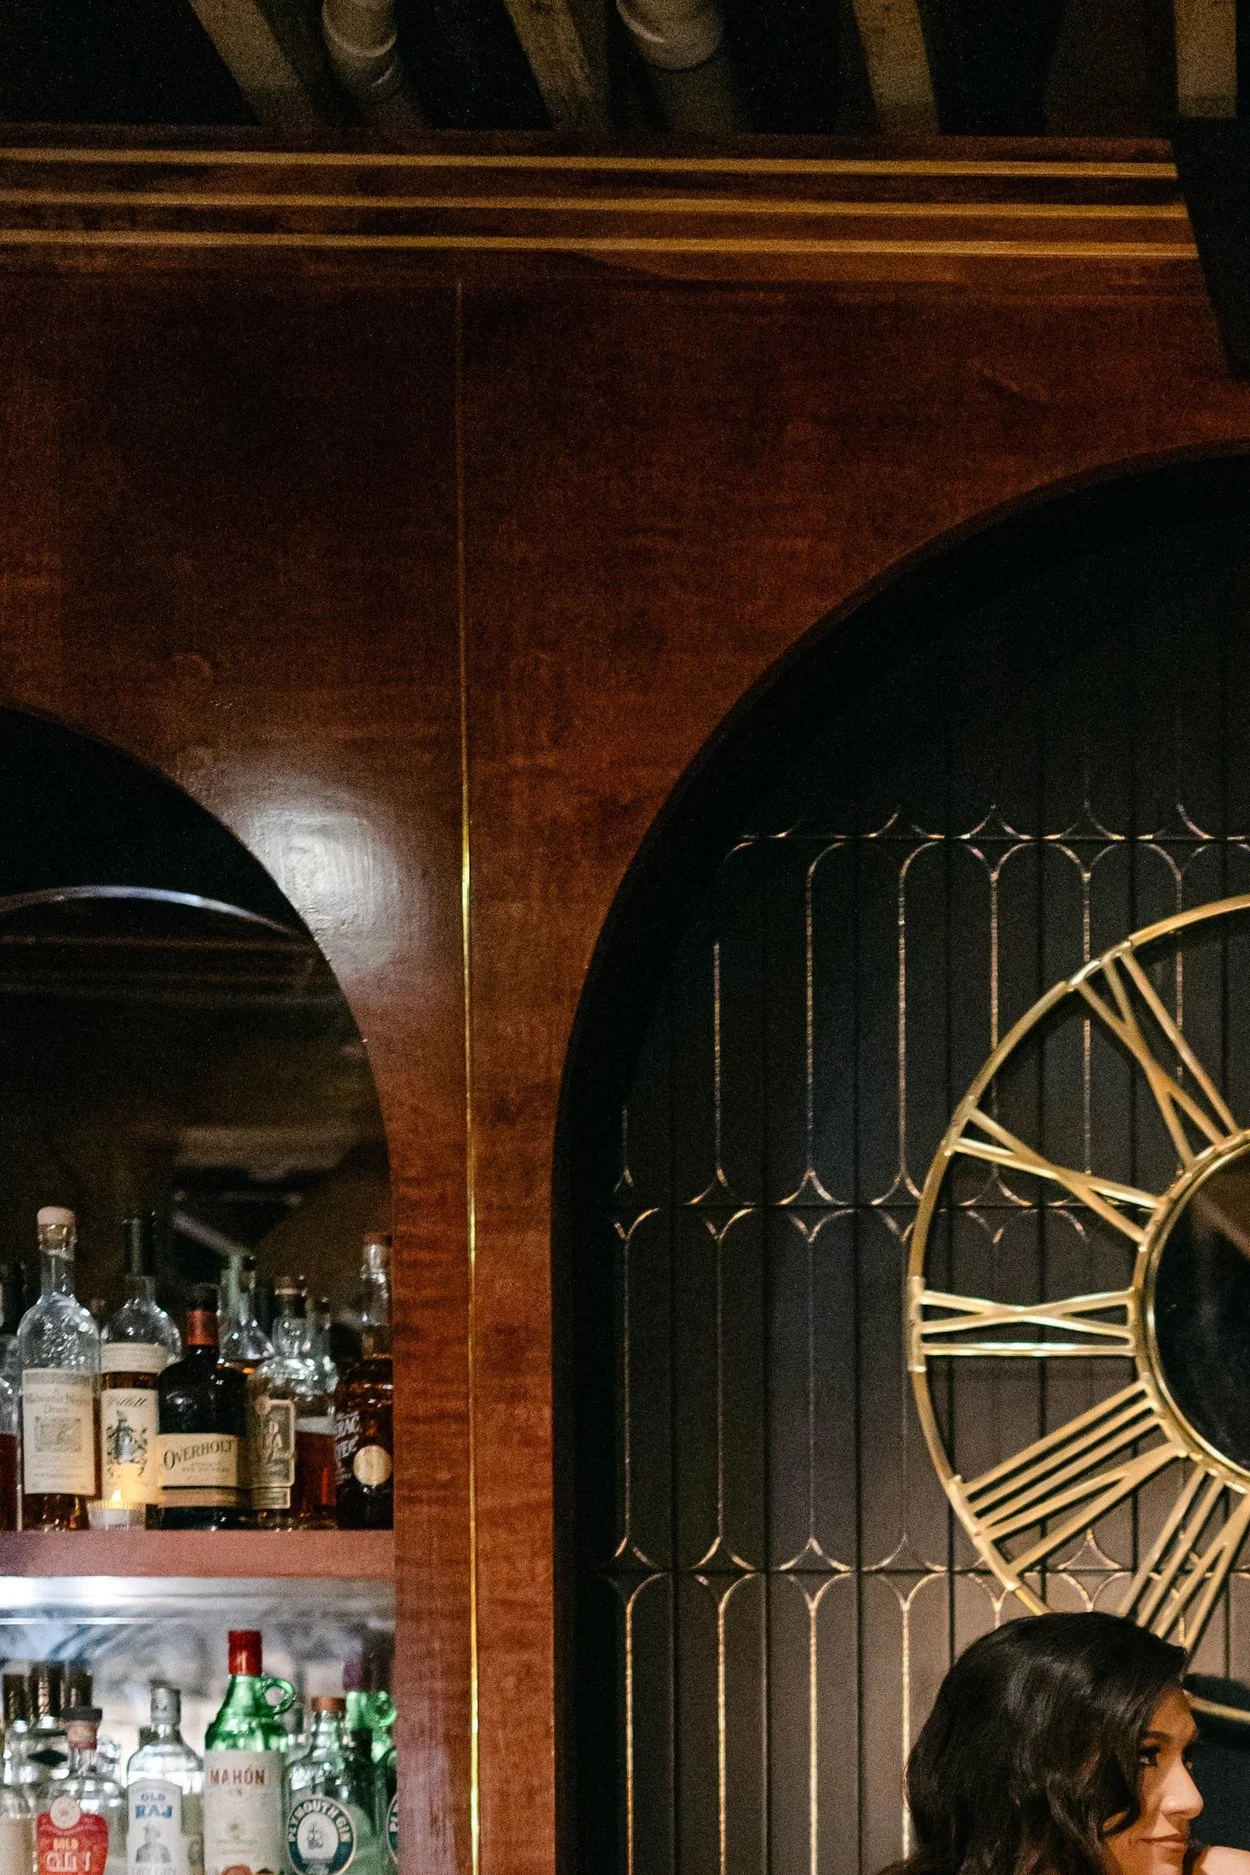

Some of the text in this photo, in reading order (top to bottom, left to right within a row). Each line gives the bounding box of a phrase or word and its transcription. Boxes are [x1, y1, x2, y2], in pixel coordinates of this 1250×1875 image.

[1070, 944, 1239, 1166] XI
[947, 1103, 1165, 1247] X
[912, 1285, 1137, 1360] IX
[163, 1439, 234, 1471] OVERHOLT
[209, 1764, 266, 1785] MAHÓN
